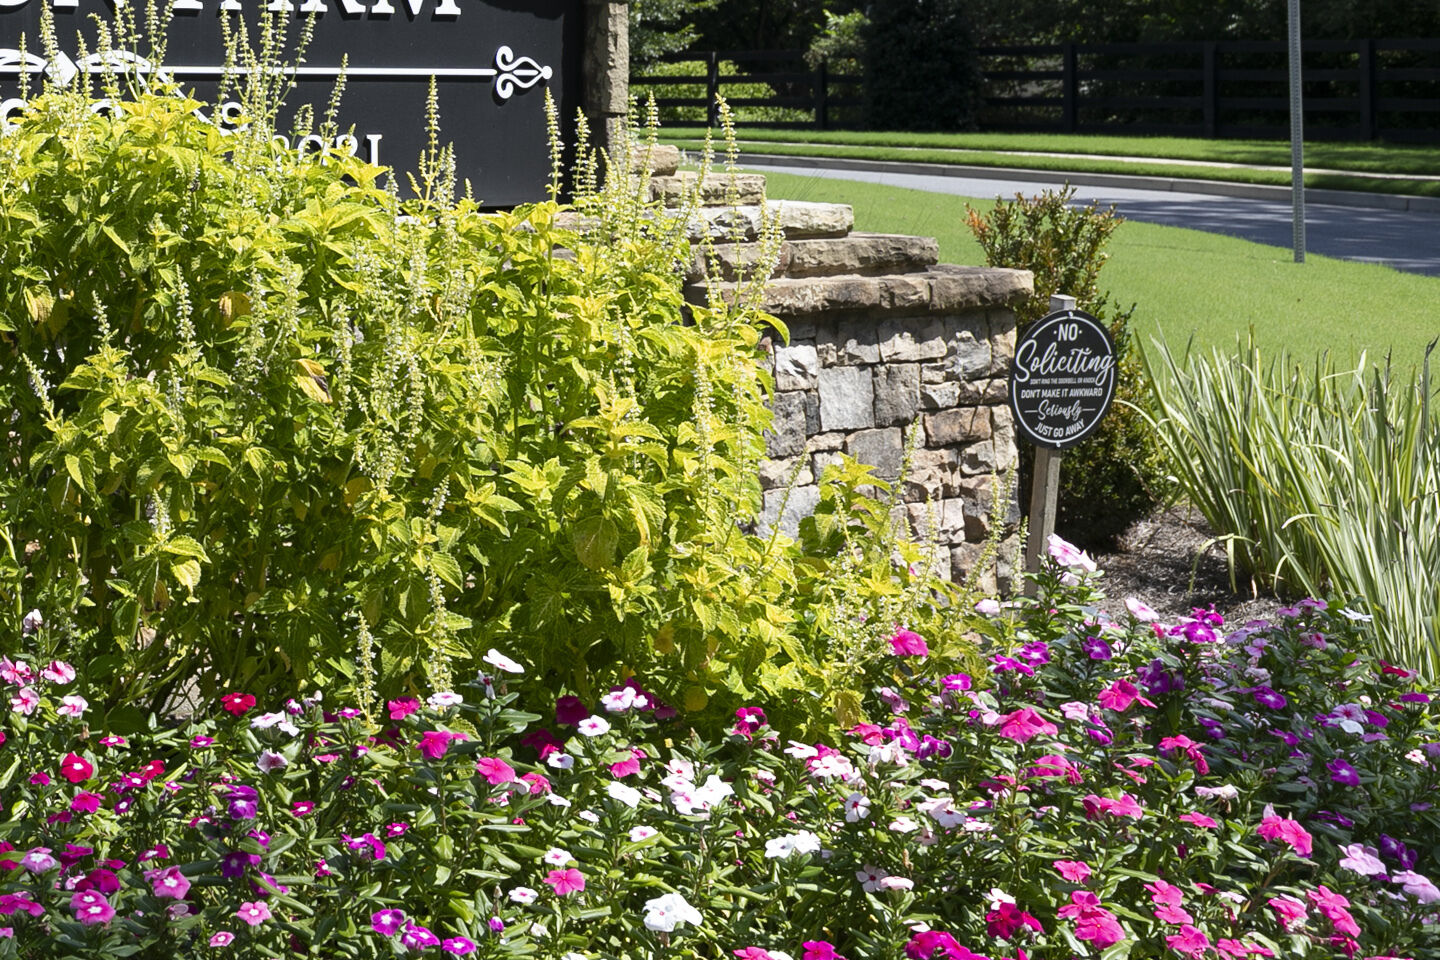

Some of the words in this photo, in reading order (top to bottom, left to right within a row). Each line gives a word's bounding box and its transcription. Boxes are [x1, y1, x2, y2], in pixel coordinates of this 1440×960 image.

[1058, 324, 1078, 341] NO
[1015, 340, 1115, 386] Soliciting
[1021, 389, 1041, 398] DON'T
[1041, 388, 1060, 398] MAKE
[1061, 388, 1068, 397] IT
[1069, 387, 1103, 397] AWKWARD
[1038, 399, 1082, 421] Seriously
[1034, 422, 1054, 437] JUST
[1053, 427, 1064, 437] GO
[1065, 418, 1085, 437] AWAY
